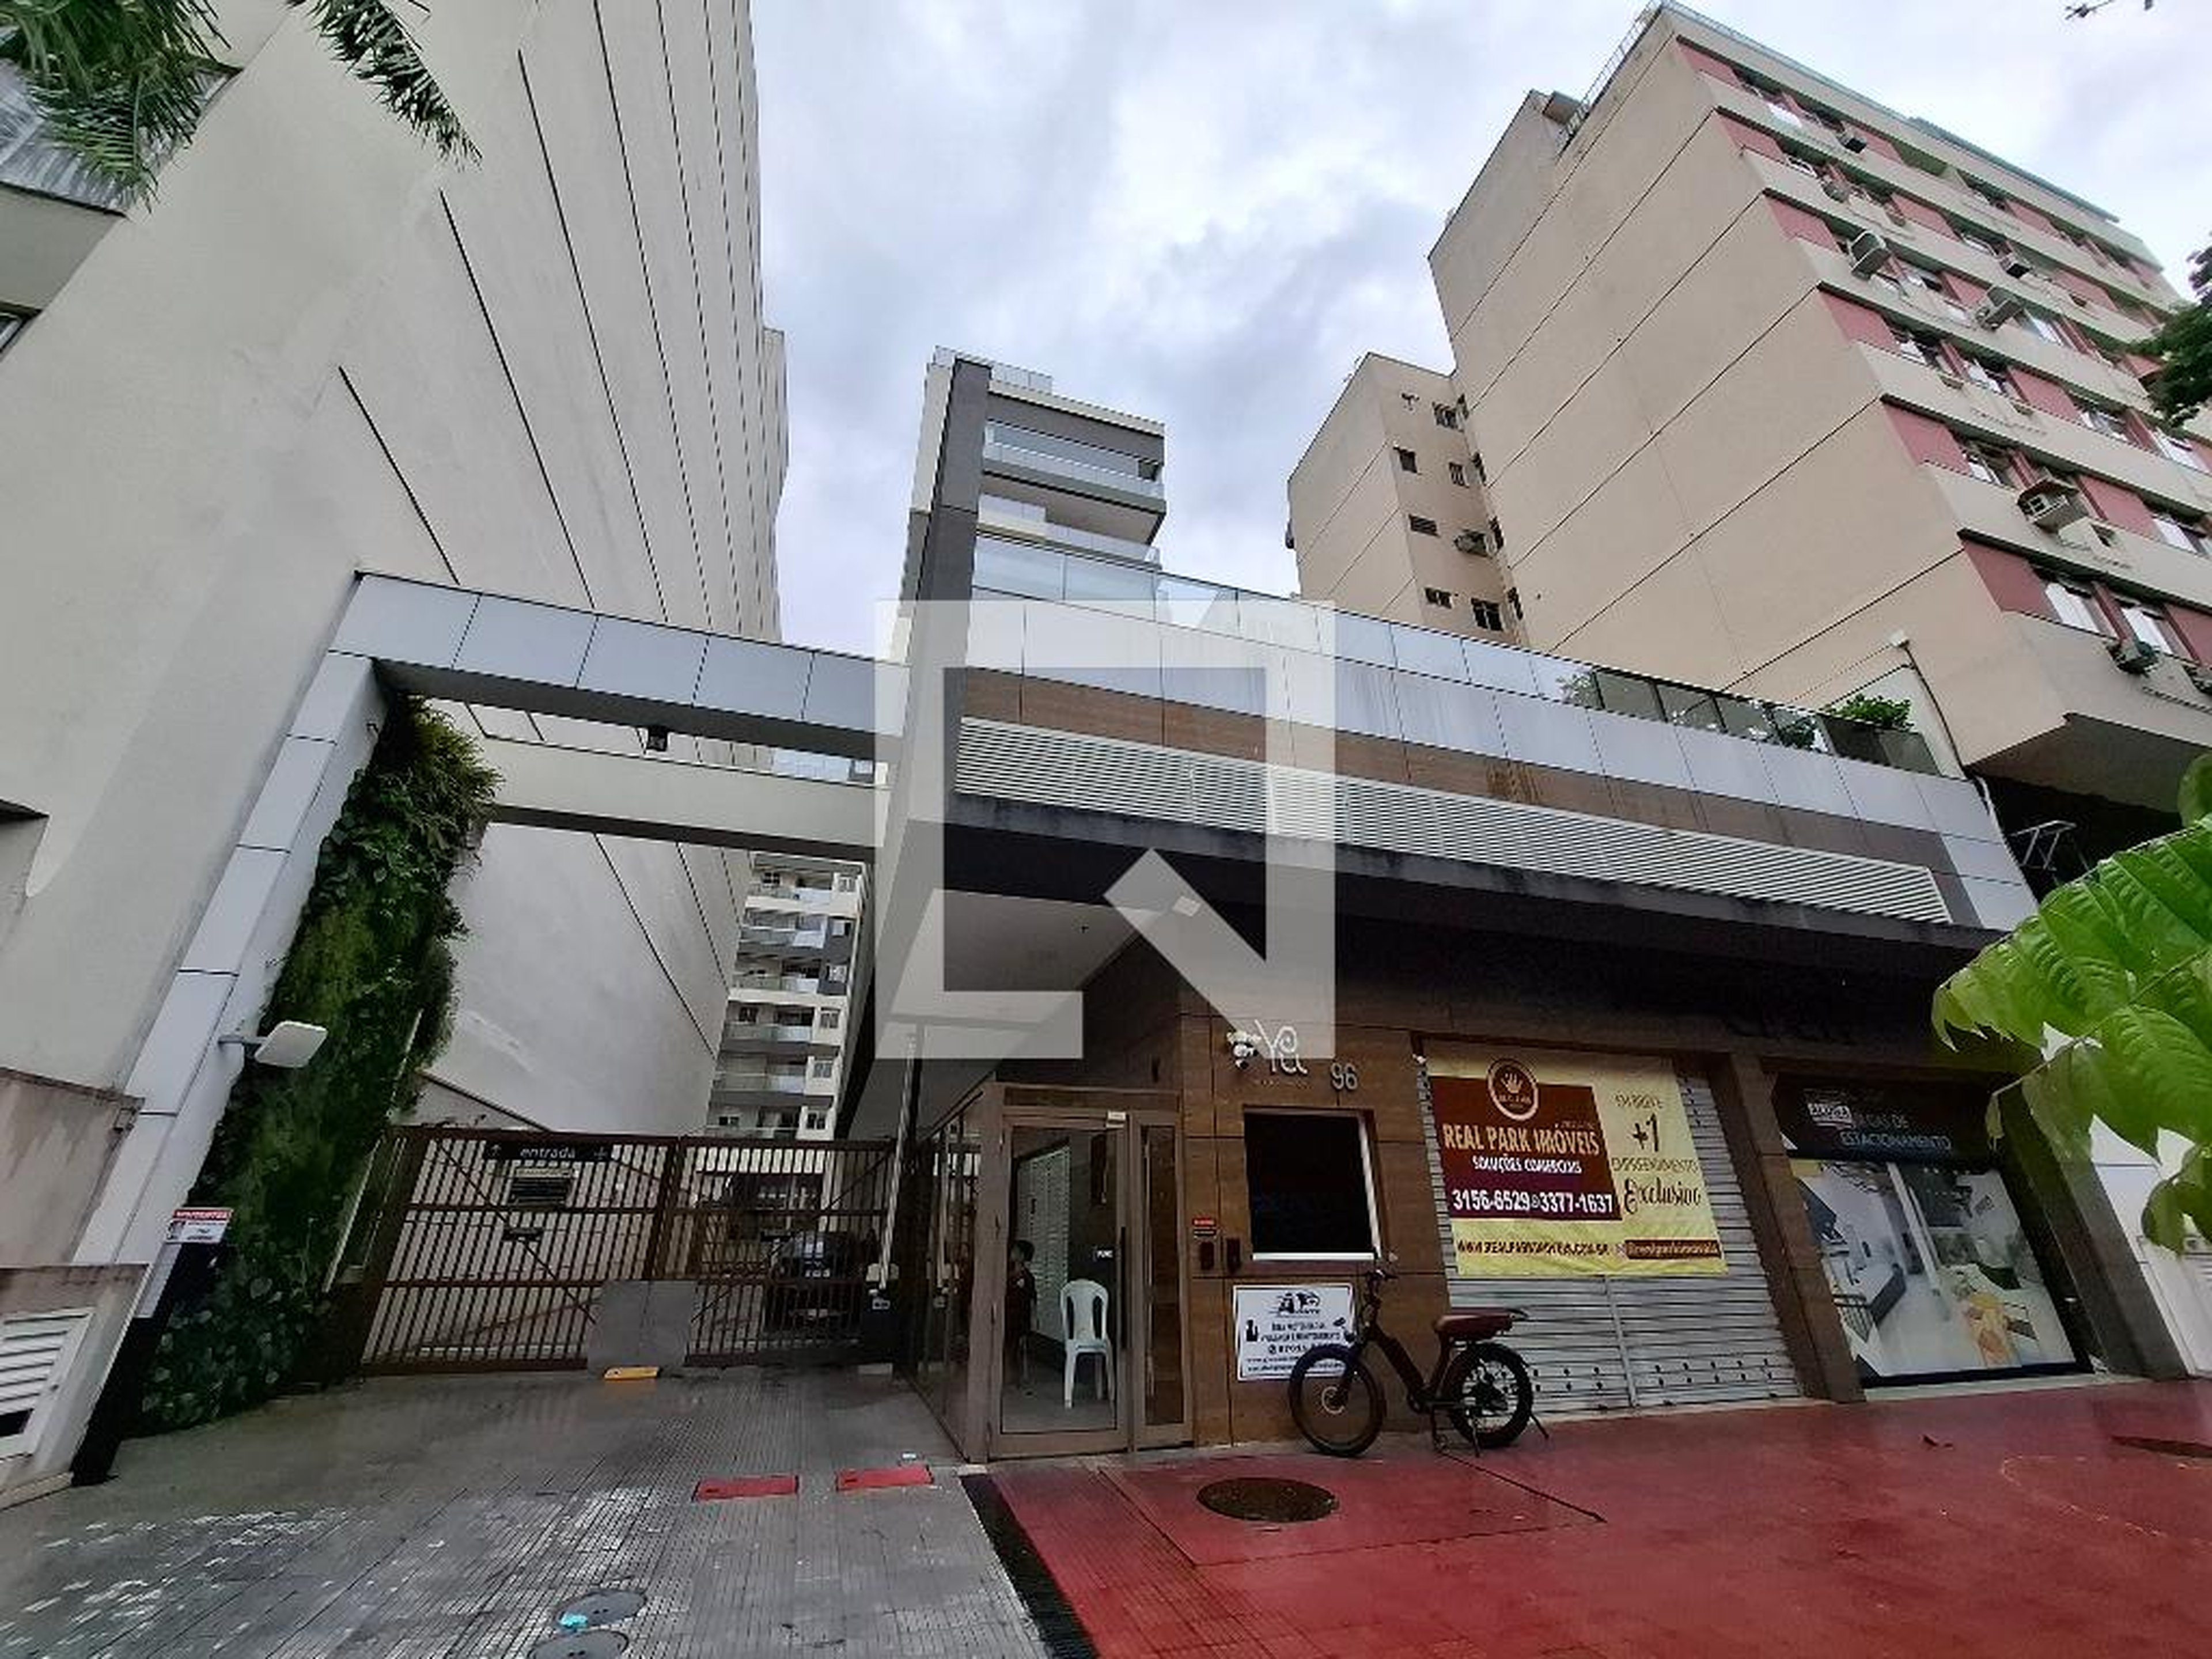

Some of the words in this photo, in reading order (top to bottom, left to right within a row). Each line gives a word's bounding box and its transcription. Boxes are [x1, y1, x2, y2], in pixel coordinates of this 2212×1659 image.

[1331, 1062, 1358, 1090] 96
[1442, 1123, 1484, 1150] REAL
[1486, 1126, 1532, 1153] PARK
[1533, 1123, 1600, 1156] IMÓVEIS
[1840, 1130, 1952, 1150] ESTACIONAMENTO
[520, 1146, 575, 1158] entrada
[1540, 1192, 1612, 1213] 3377-1637
